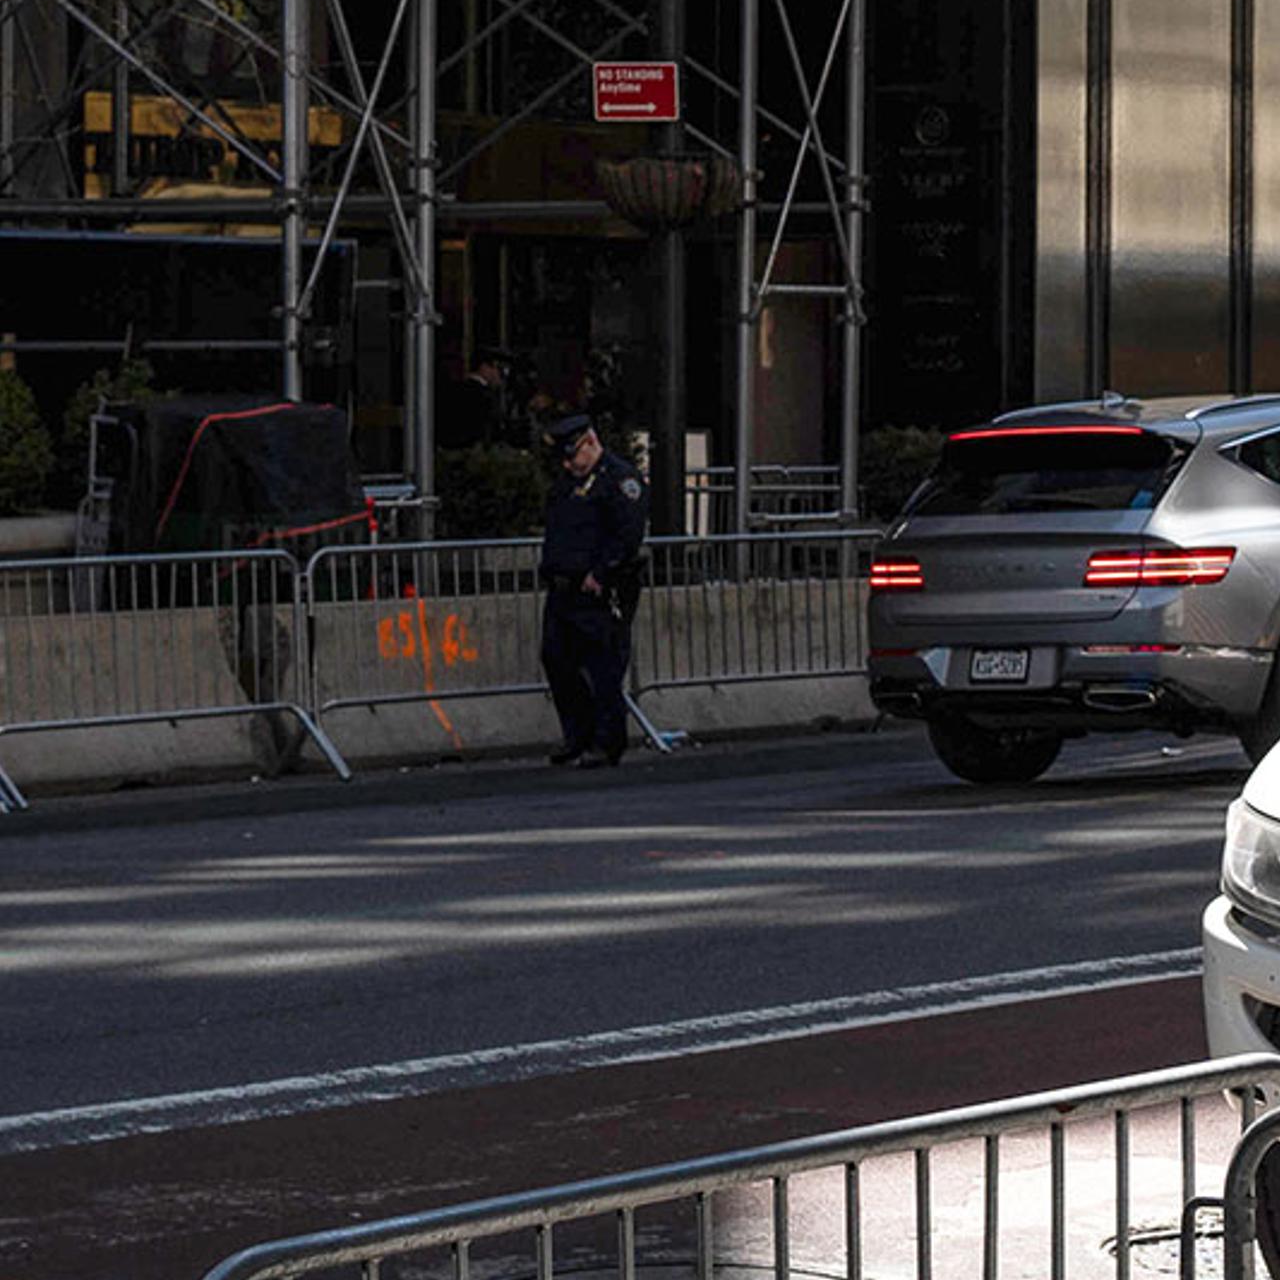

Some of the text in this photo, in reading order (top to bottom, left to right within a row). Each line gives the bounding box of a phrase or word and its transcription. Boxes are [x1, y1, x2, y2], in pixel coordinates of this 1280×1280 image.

[599, 68, 664, 81] NO STANDING
[599, 83, 641, 95] Anytime
